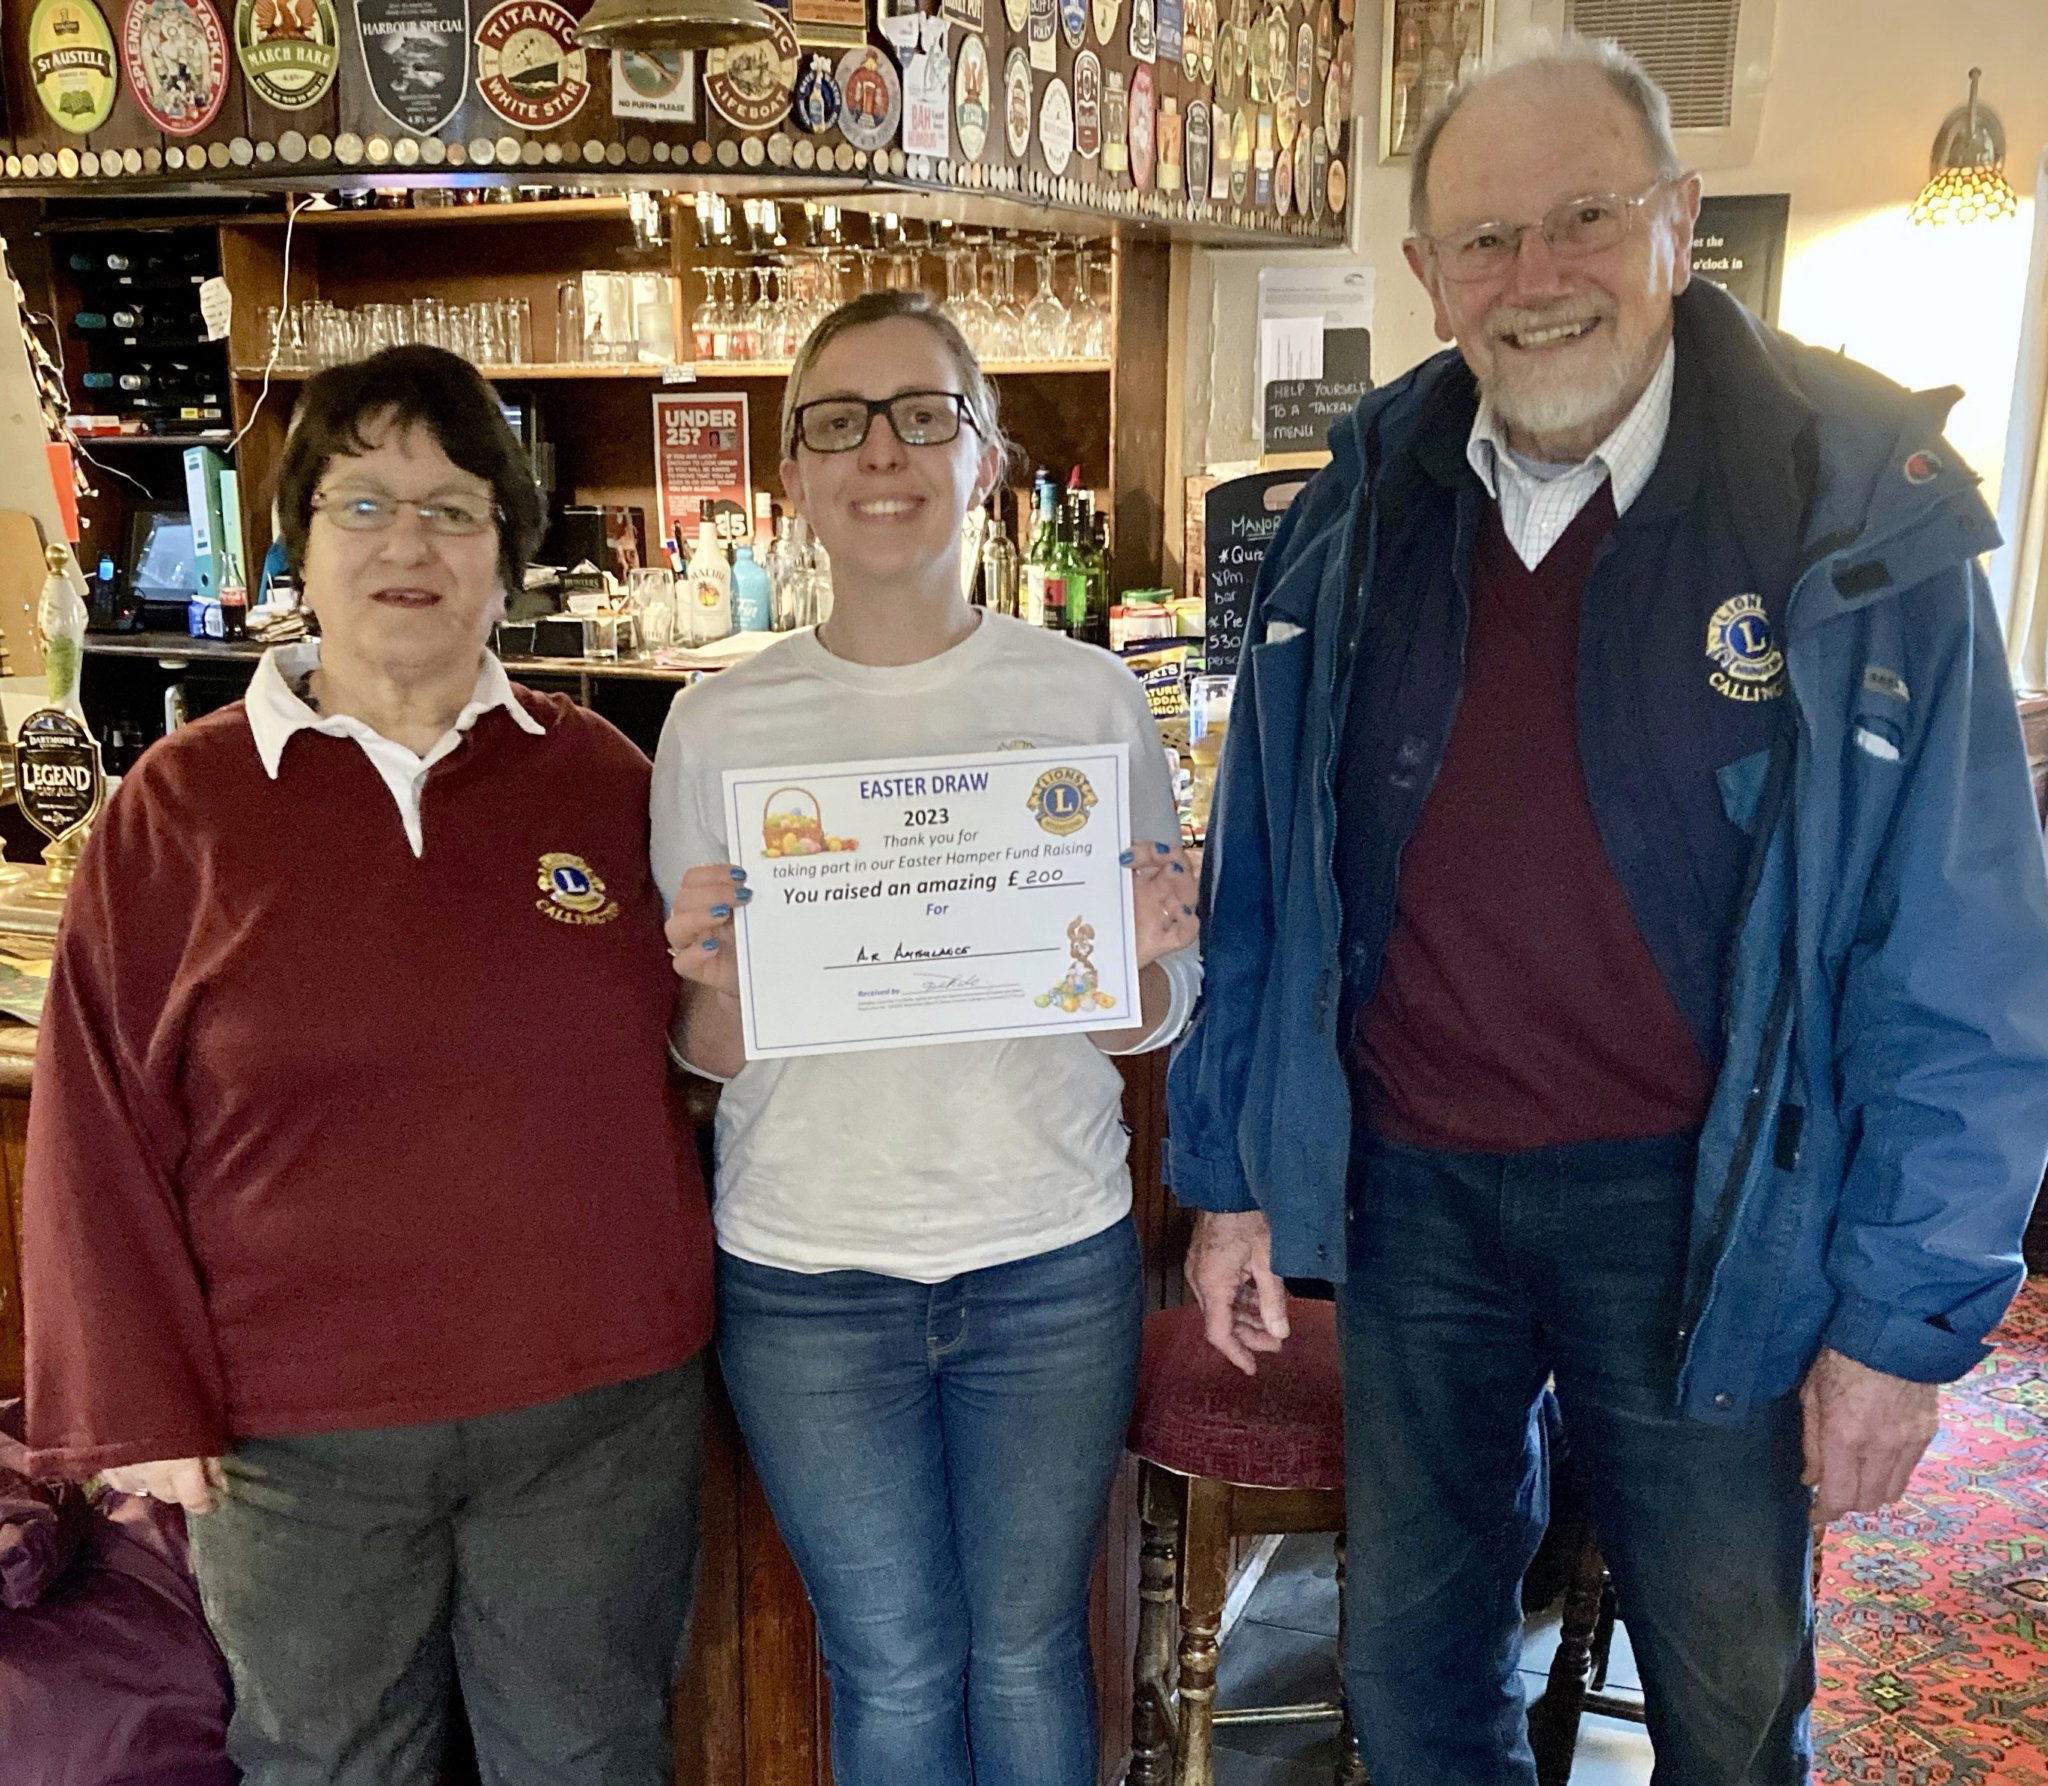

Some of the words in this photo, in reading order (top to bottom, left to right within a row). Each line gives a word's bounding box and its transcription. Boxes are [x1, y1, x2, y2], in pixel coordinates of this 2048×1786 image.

[362, 21, 417, 35] HARBOUR
[421, 20, 465, 33] SPECIAL
[487, 5, 574, 44] TITANIC
[52, 50, 105, 67] AUSTELL
[247, 47, 291, 67] MARCH
[296, 47, 331, 68] HARE
[488, 78, 538, 119] WHITE
[543, 81, 580, 117] STAR
[618, 100, 630, 108] NO
[631, 101, 657, 110] PUFFIN
[658, 103, 685, 112] PLEASE
[714, 82, 786, 119] LIFEBOAT
[1692, 257, 1730, 270] o'clock
[1731, 257, 1743, 270] in
[1274, 382, 1305, 399] HELP
[1314, 381, 1367, 397] YOURSELF
[1291, 404, 1300, 416] A
[1308, 401, 1354, 415] TAKEA
[665, 409, 737, 428] UNDER
[666, 428, 701, 446] 25?
[715, 514, 746, 537] 25
[1716, 593, 1763, 621] LION
[1738, 621, 1766, 653] L
[1207, 655, 1239, 671] perso
[1151, 705, 1183, 715] NION
[21, 762, 91, 791] LEGEND
[860, 777, 926, 799] EASTER
[932, 772, 989, 794] DRAW
[1041, 770, 1082, 786] LIONS
[1054, 788, 1073, 813] L
[904, 808, 949, 827] 2023
[883, 833, 925, 849] Thank
[929, 833, 954, 848] you
[956, 829, 979, 846] for
[773, 864, 817, 879] taking
[820, 862, 850, 878] part
[854, 860, 867, 872] in
[871, 858, 895, 871] our
[898, 852, 941, 869] Easter
[946, 851, 1002, 866] Hamper
[1005, 845, 1040, 860] Fund
[1043, 842, 1093, 858] Raising
[559, 869, 586, 893] L
[783, 888, 818, 905] You
[824, 880, 882, 901] raised
[888, 883, 911, 896] an
[917, 873, 997, 895] amazing
[1026, 869, 1063, 884] 200
[926, 903, 949, 916] For
[858, 989, 890, 997] Received
